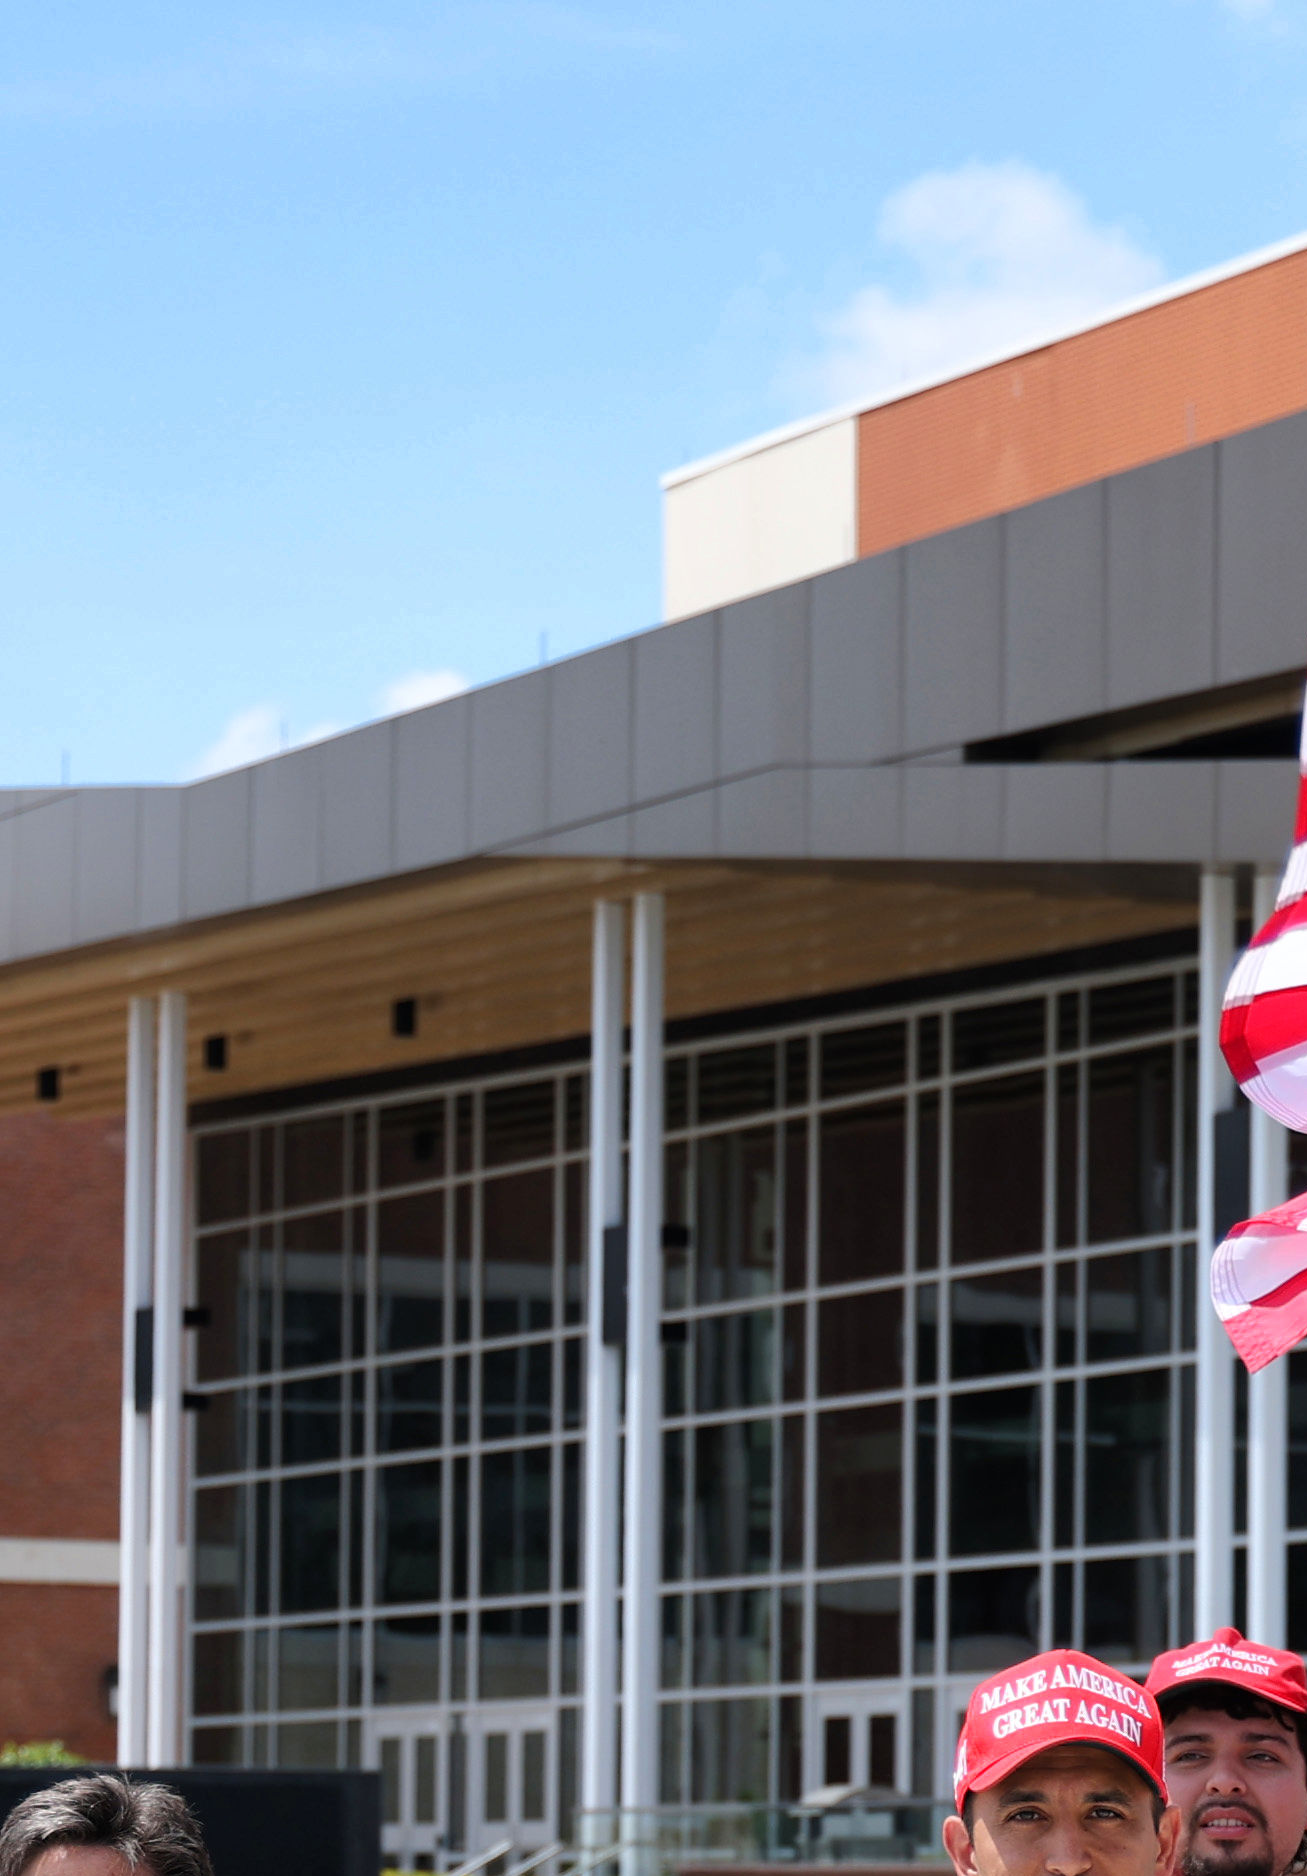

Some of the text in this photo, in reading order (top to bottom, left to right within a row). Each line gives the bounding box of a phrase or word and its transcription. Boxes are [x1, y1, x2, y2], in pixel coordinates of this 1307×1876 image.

[1175, 1656, 1270, 1677] GREAT AGAIN
[1209, 1643, 1279, 1667] AMERICA
[980, 1664, 1152, 1719] MAKE AMERICA
[992, 1698, 1143, 1748] GREAT AGAIN
